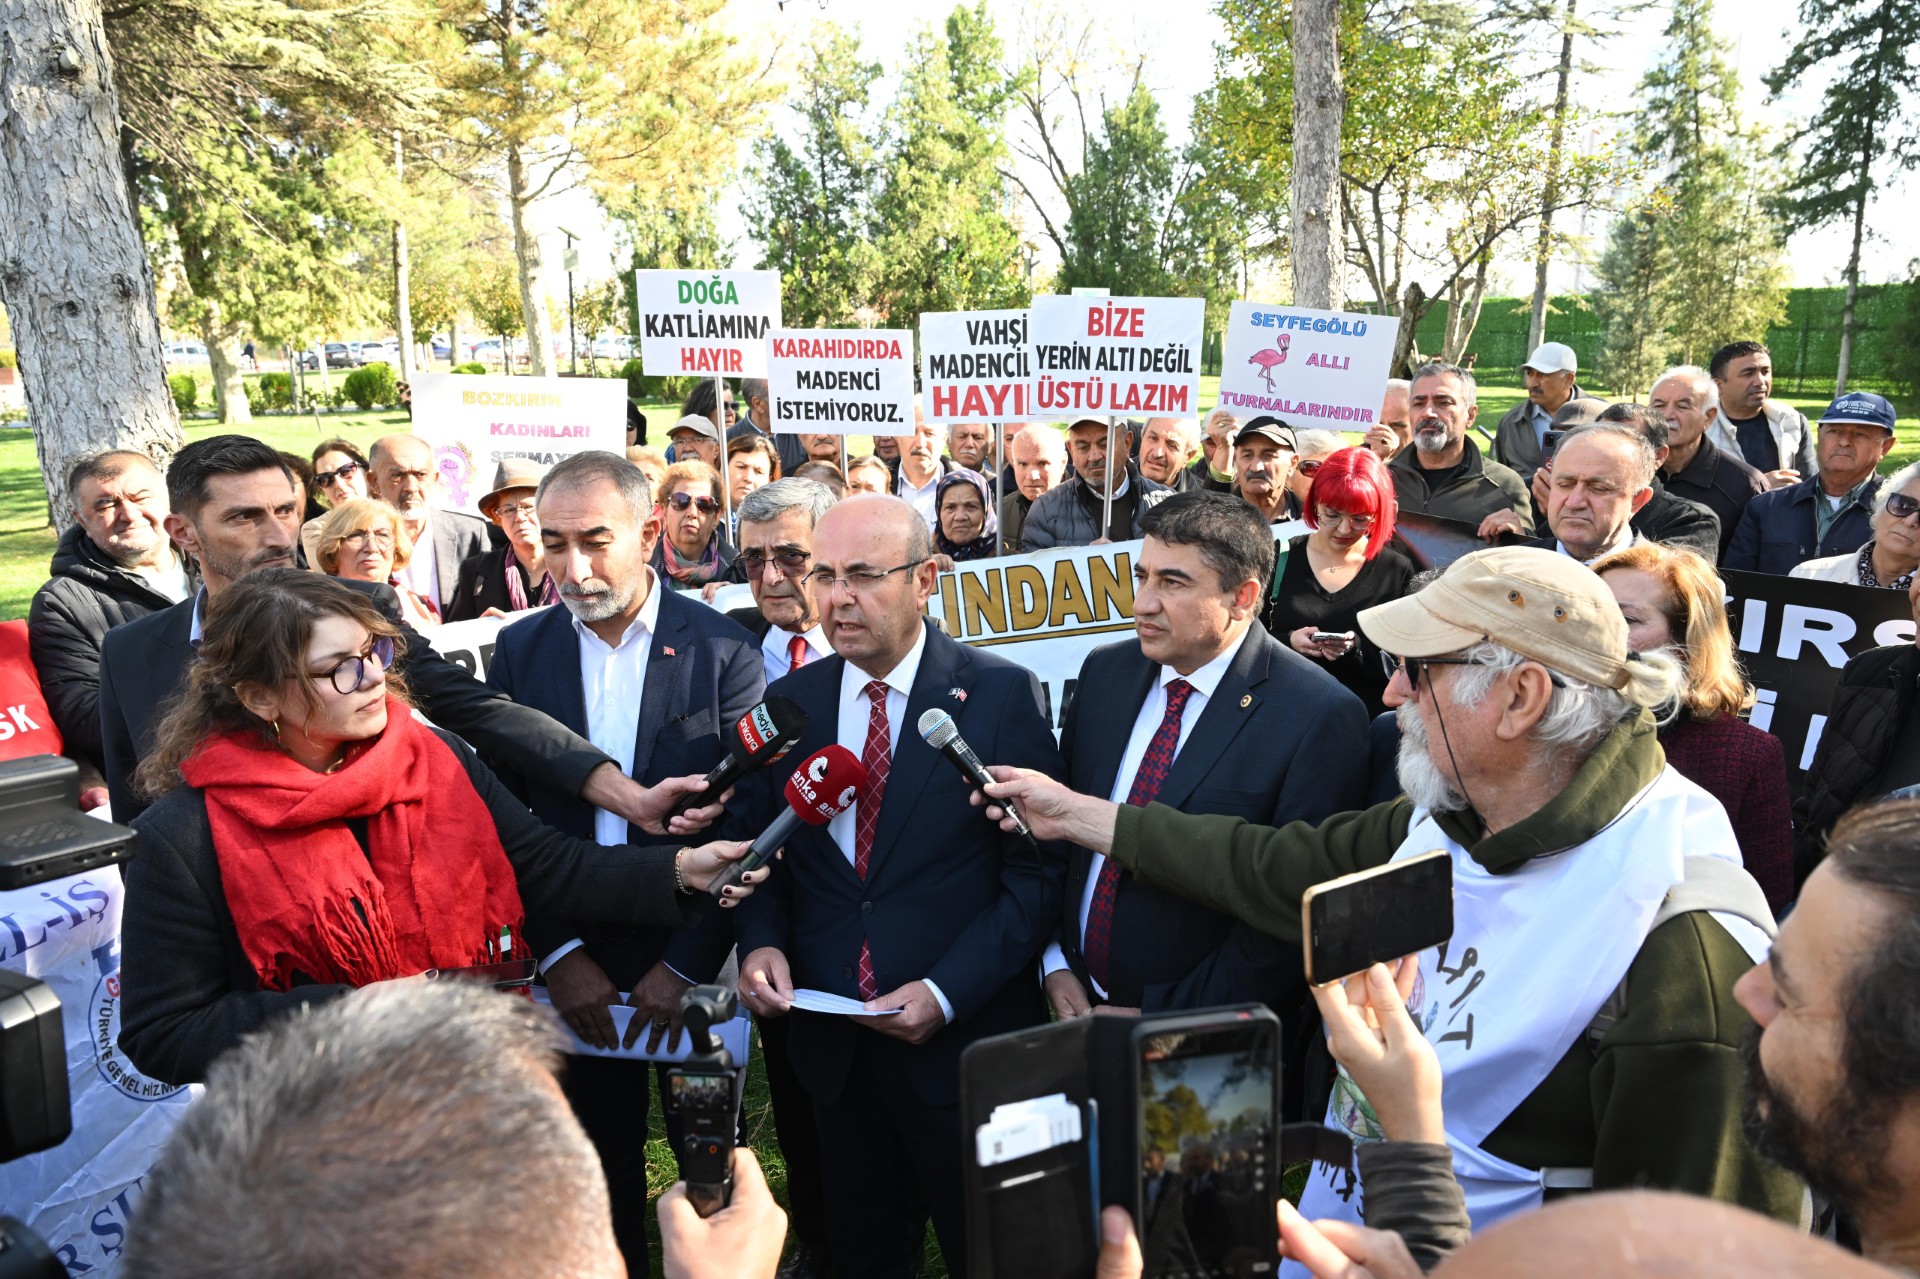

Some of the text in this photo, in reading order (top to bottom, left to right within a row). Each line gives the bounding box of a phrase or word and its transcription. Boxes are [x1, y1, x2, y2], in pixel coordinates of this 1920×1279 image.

[677, 274, 739, 305] DOĞA
[645, 309, 770, 339] KATLİAMINA
[966, 313, 1028, 349] VAHŞİ
[1087, 301, 1145, 338] BİZE
[1250, 311, 1368, 337] SEYFEGÖLÜ
[681, 347, 743, 372] HAYIR
[773, 338, 902, 359] KARAHIDIRDA
[1036, 341, 1193, 374] YERİN ALTI DEĞİL
[1306, 352, 1350, 371] ALLI
[796, 368, 881, 390] MADENCİ
[1038, 375, 1188, 412] ÜSTÜ LAZIM
[462, 390, 562, 407] BOZKIRIN
[776, 397, 904, 422] İSTEMİYORUZ.
[932, 384, 1030, 417] HAYI
[1221, 390, 1373, 423] TURNALARINDIR
[490, 422, 589, 438] KADINLARI
[740, 717, 758, 752] ankara
[755, 706, 775, 739] medya
[793, 770, 817, 800] anka
[98, 998, 116, 1062] TÜRKİYE
[106, 1060, 140, 1094] GENEL
